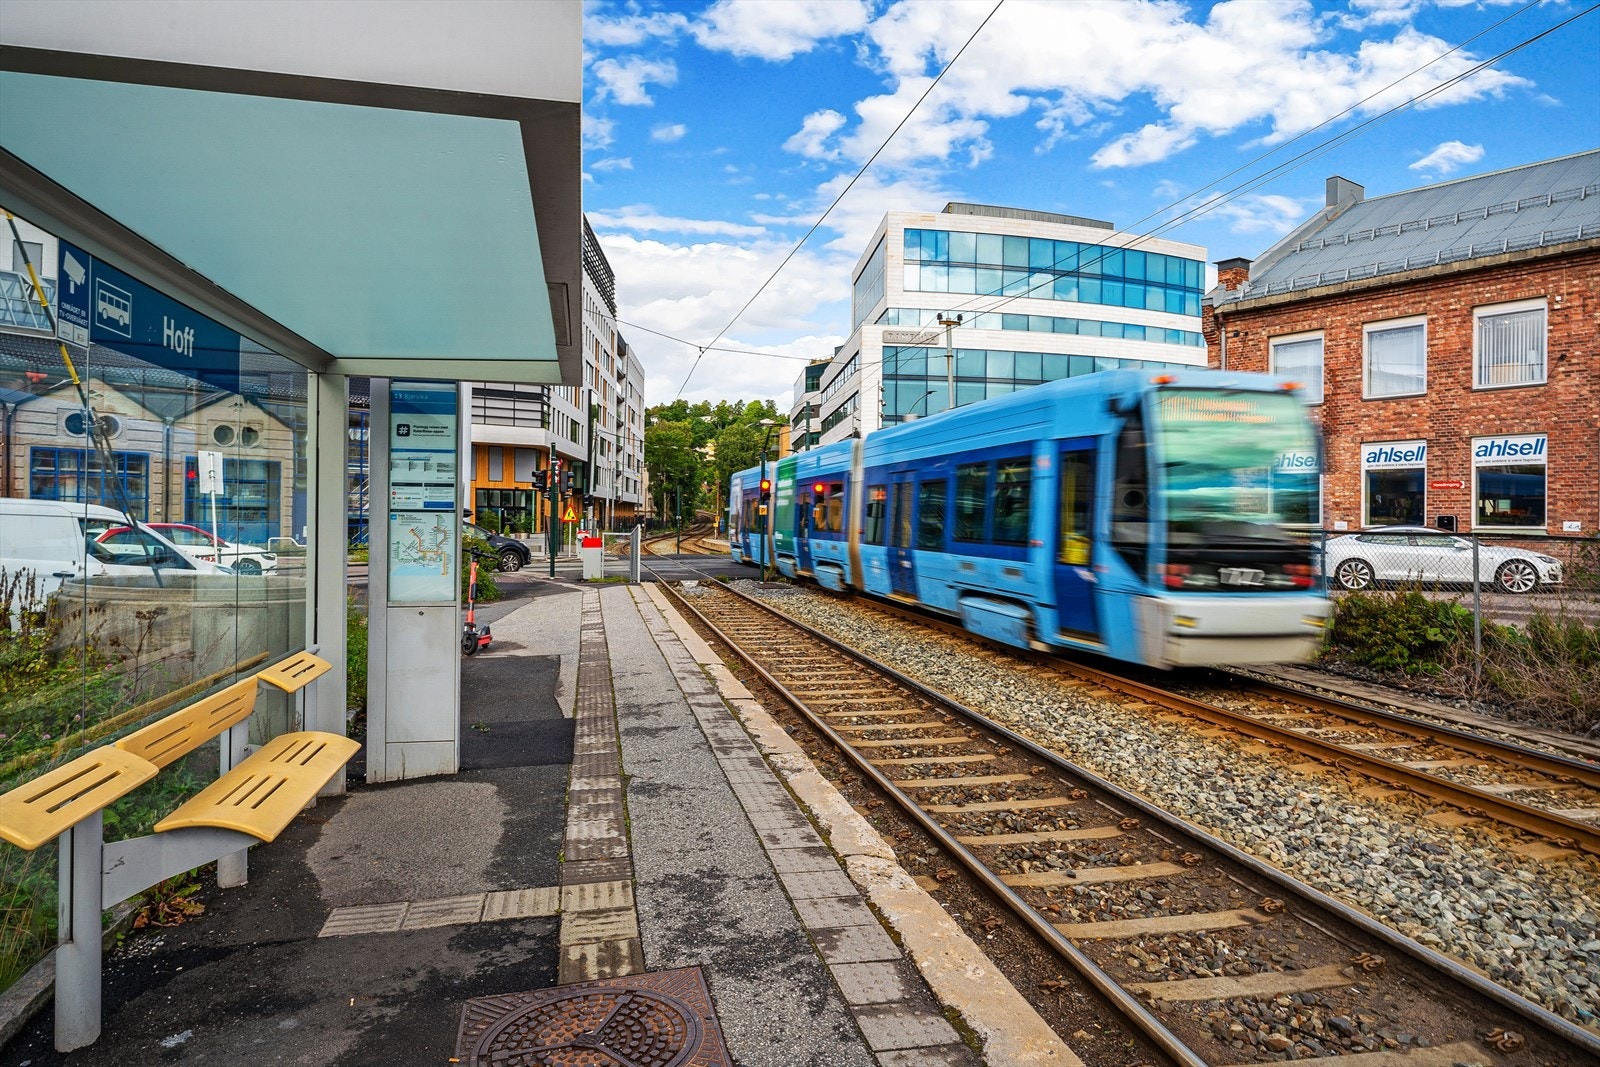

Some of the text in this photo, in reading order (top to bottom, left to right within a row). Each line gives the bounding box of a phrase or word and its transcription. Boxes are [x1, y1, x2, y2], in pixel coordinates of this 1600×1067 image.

[163, 315, 194, 357] Hoff
[1366, 446, 1426, 463] ahlsell
[1475, 438, 1546, 457] ahlsell
